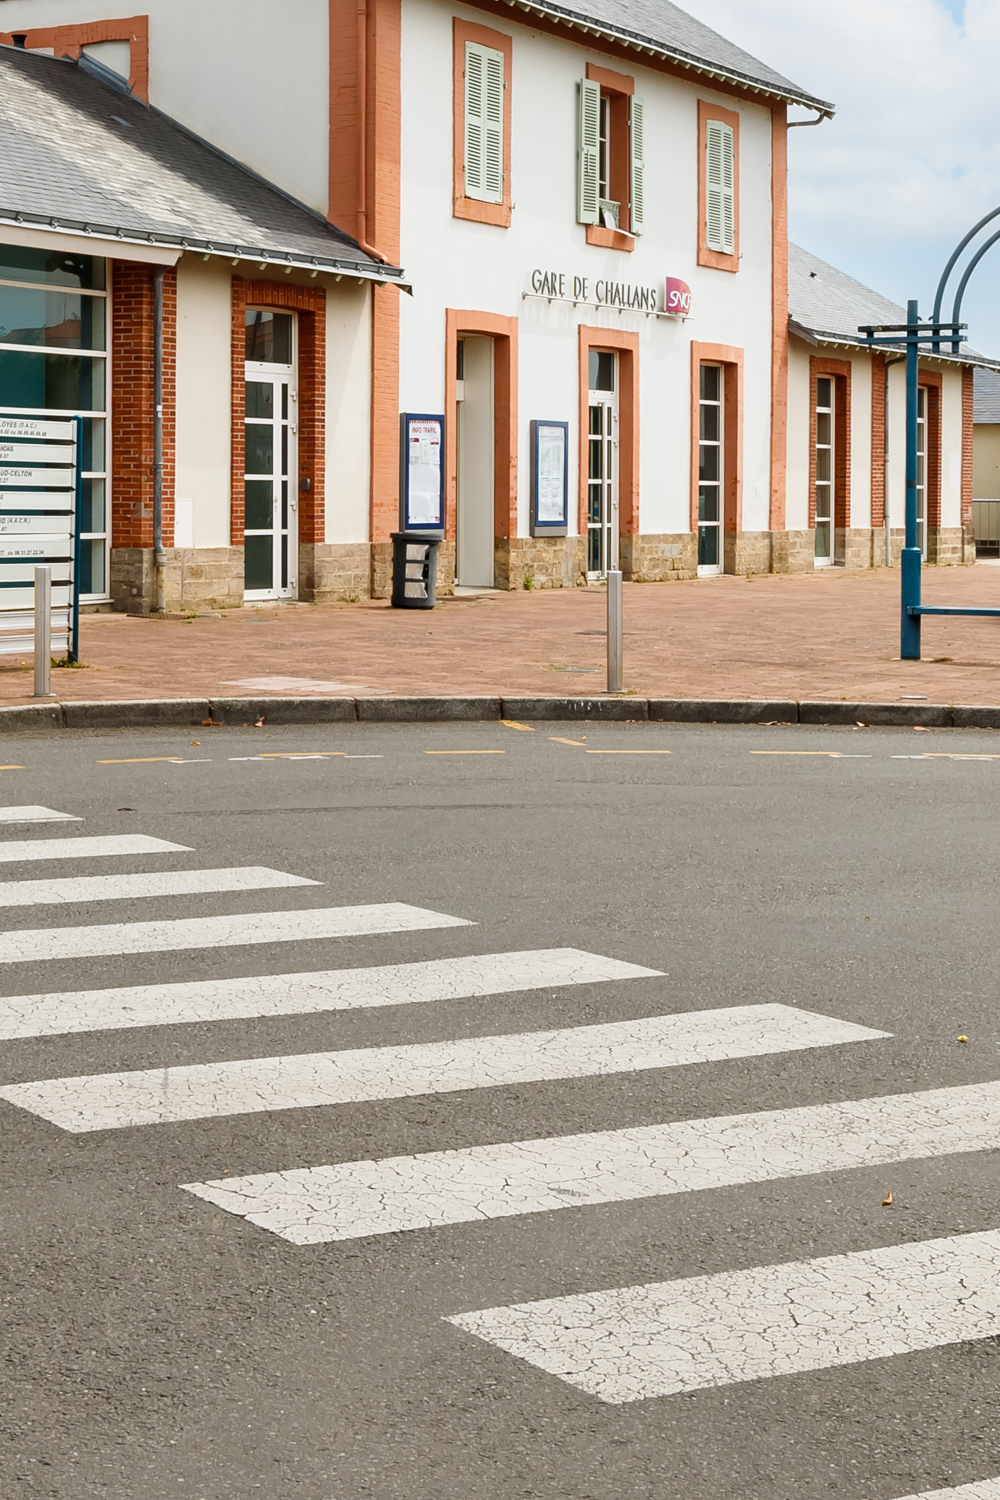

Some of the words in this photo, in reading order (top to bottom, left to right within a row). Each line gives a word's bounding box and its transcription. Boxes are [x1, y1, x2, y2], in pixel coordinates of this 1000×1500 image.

[531, 268, 566, 297] GARE
[573, 275, 589, 299] DE
[595, 279, 657, 310] CHALLANS
[668, 290, 692, 310] SNCF
